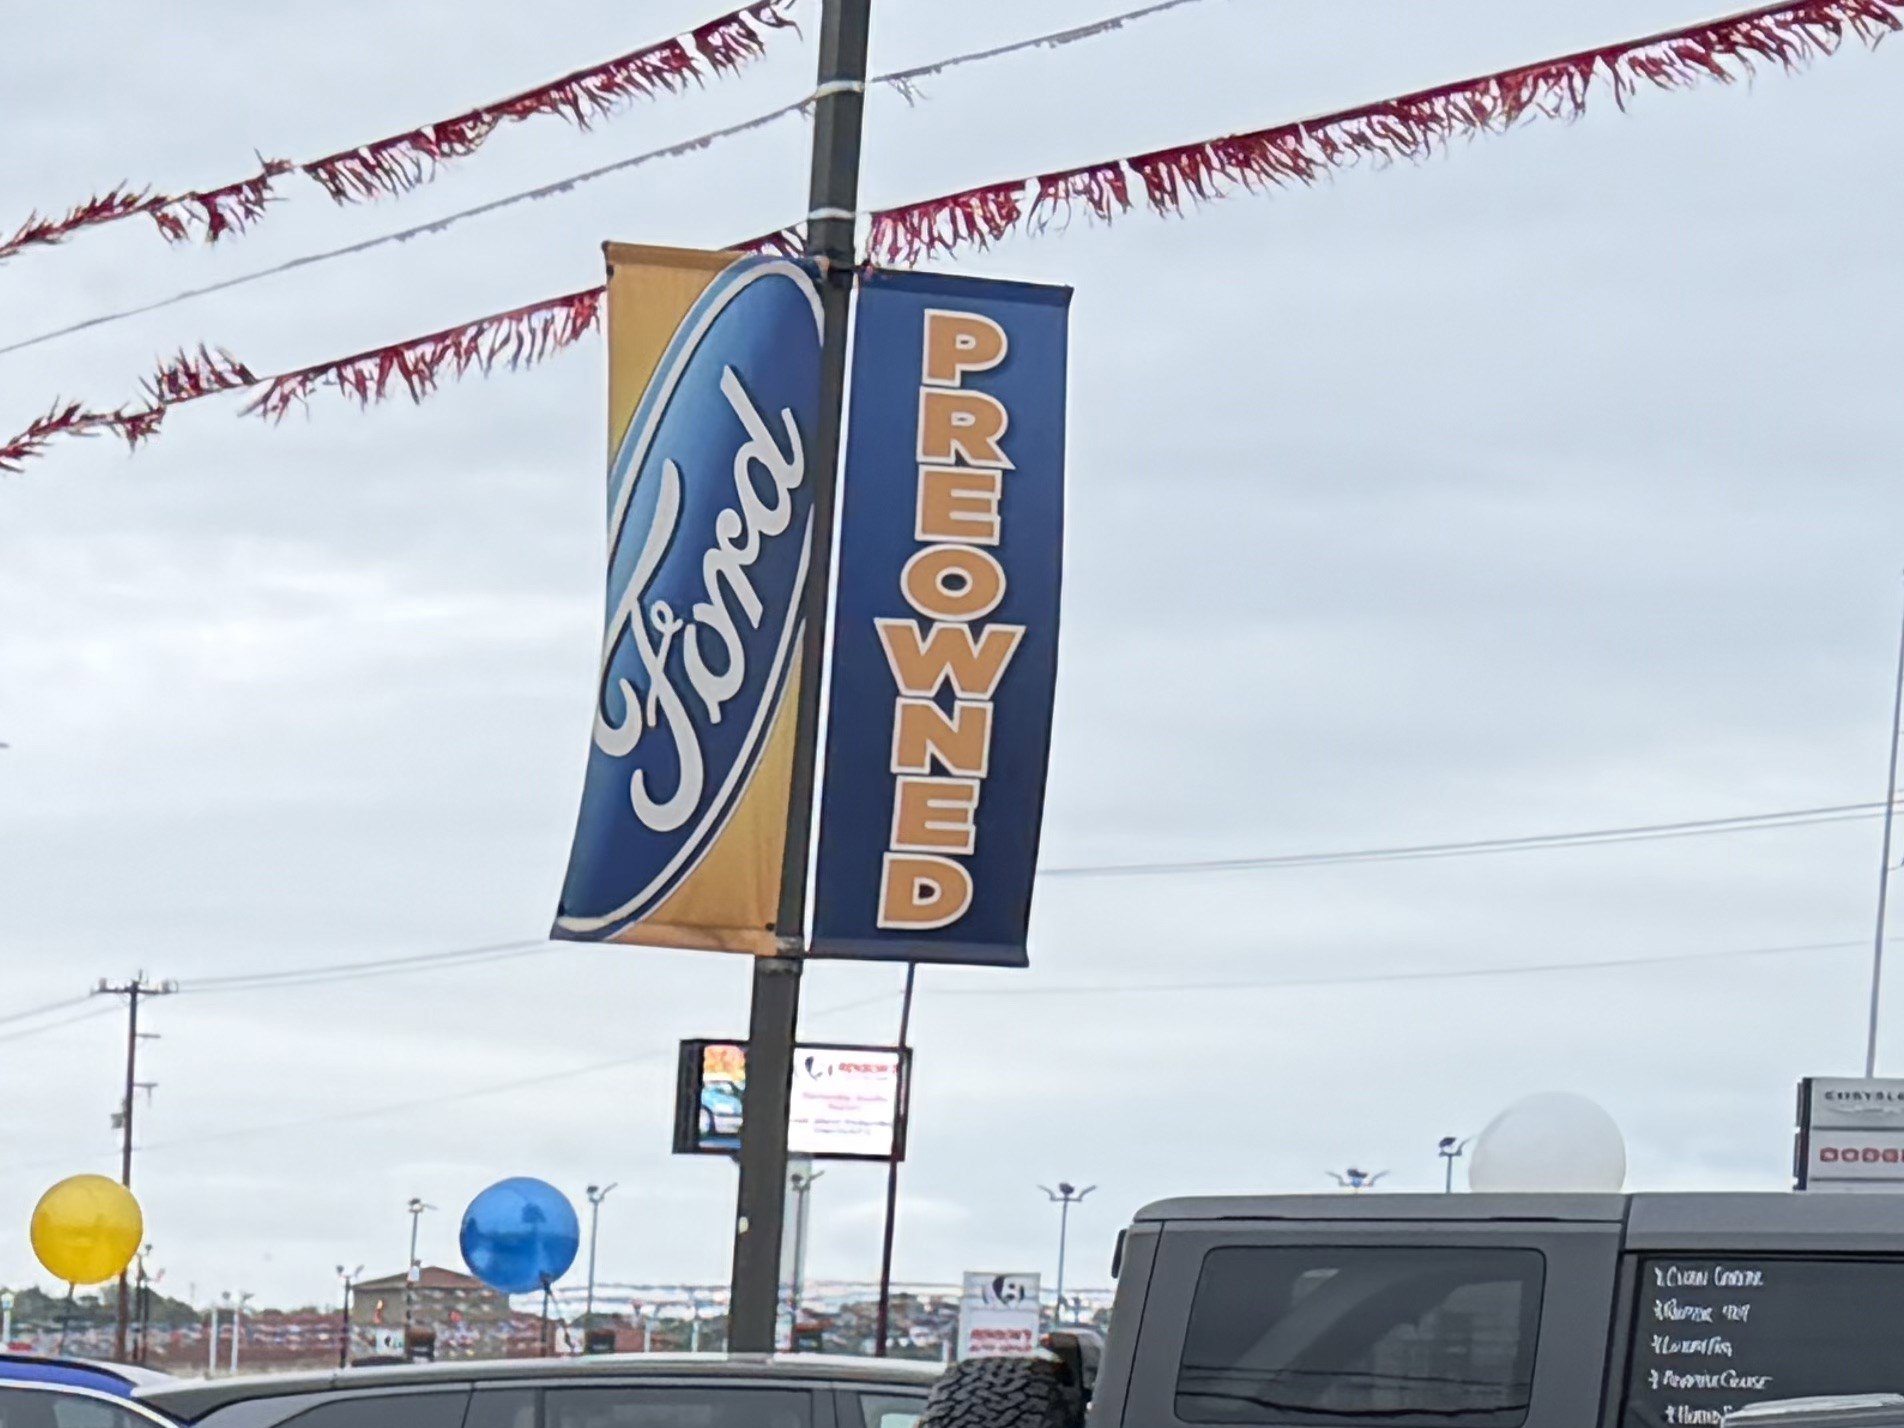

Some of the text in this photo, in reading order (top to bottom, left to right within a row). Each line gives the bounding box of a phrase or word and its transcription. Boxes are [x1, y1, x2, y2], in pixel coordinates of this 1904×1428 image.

[593, 363, 806, 832] Ford
[874, 307, 1026, 930] PREOWNED
[1819, 1146, 1904, 1164] DODG
[1824, 1090, 1904, 1102] CHRYSLE
